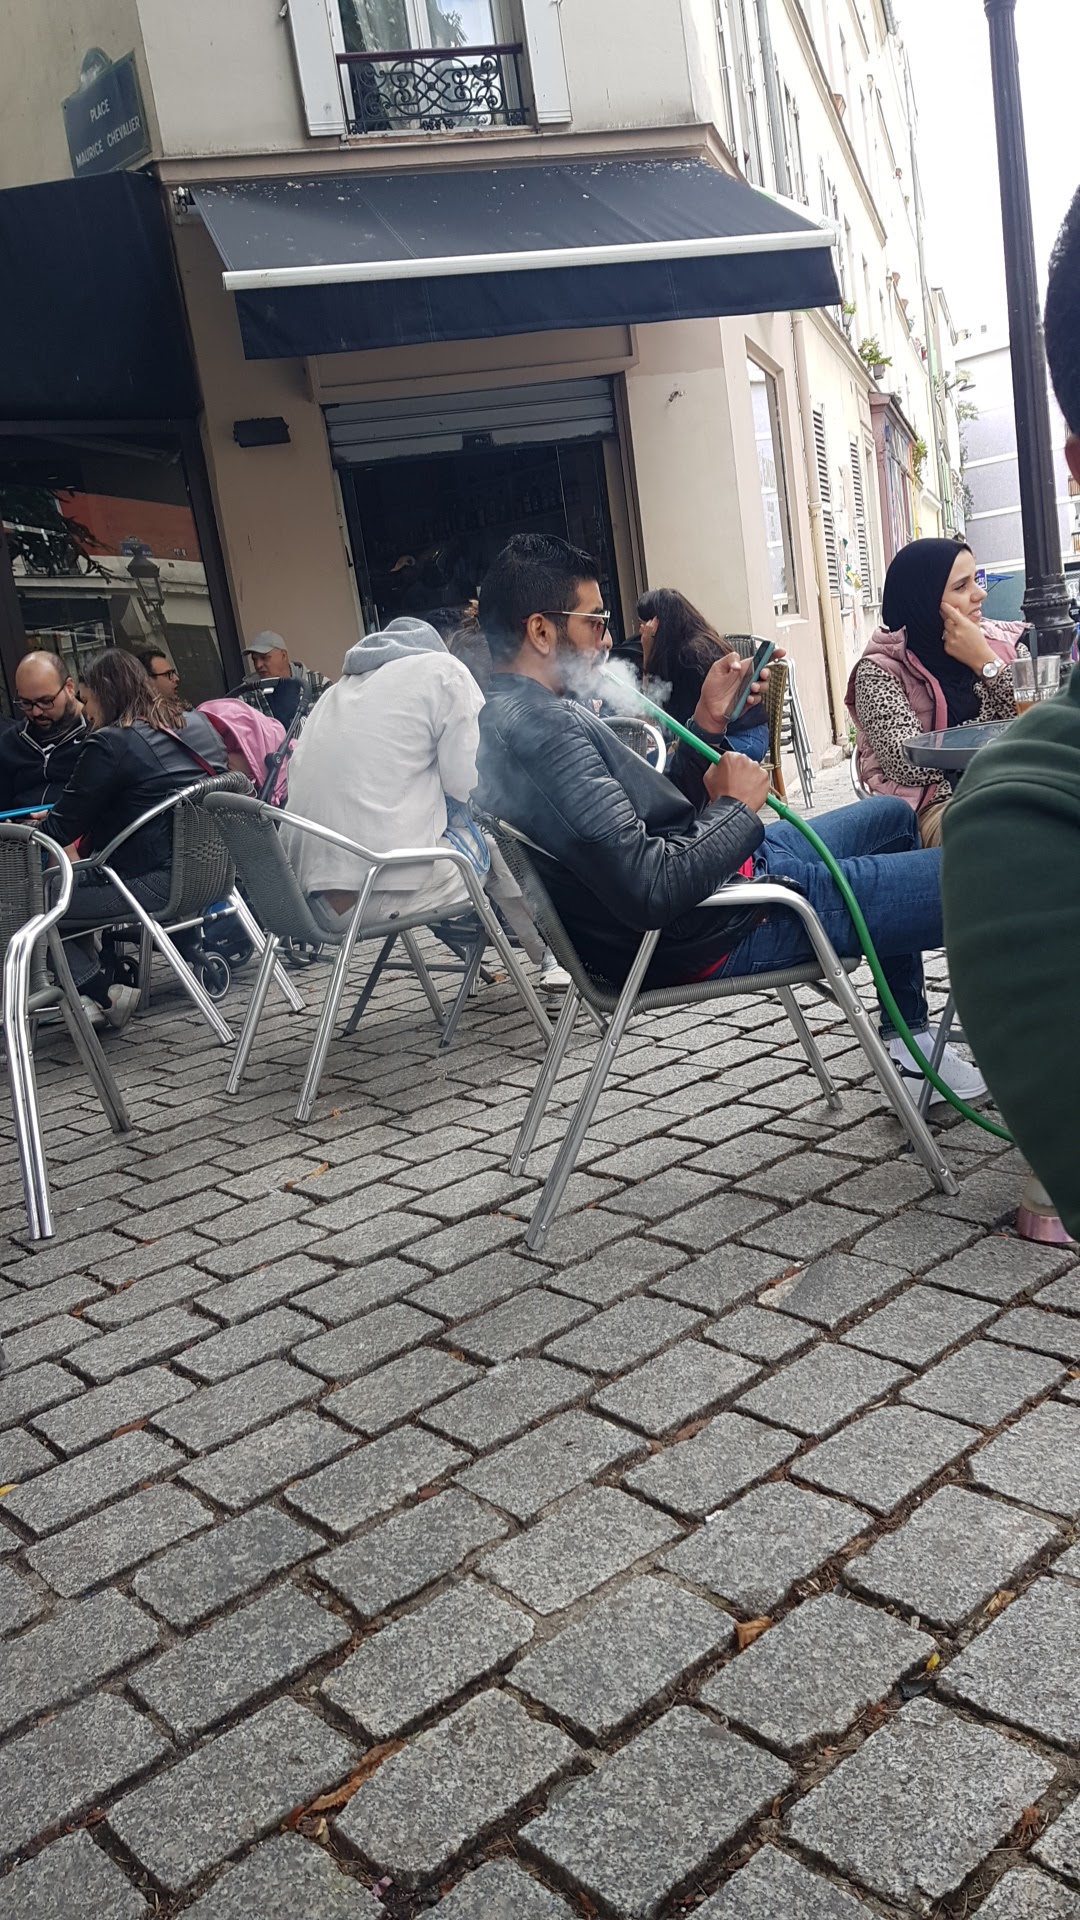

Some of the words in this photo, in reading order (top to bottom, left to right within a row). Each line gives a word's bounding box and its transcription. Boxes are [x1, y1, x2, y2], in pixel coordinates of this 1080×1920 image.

[90, 98, 110, 123] PLACE
[75, 139, 104, 168] MAURICE
[106, 115, 141, 148] CHEVALIER
